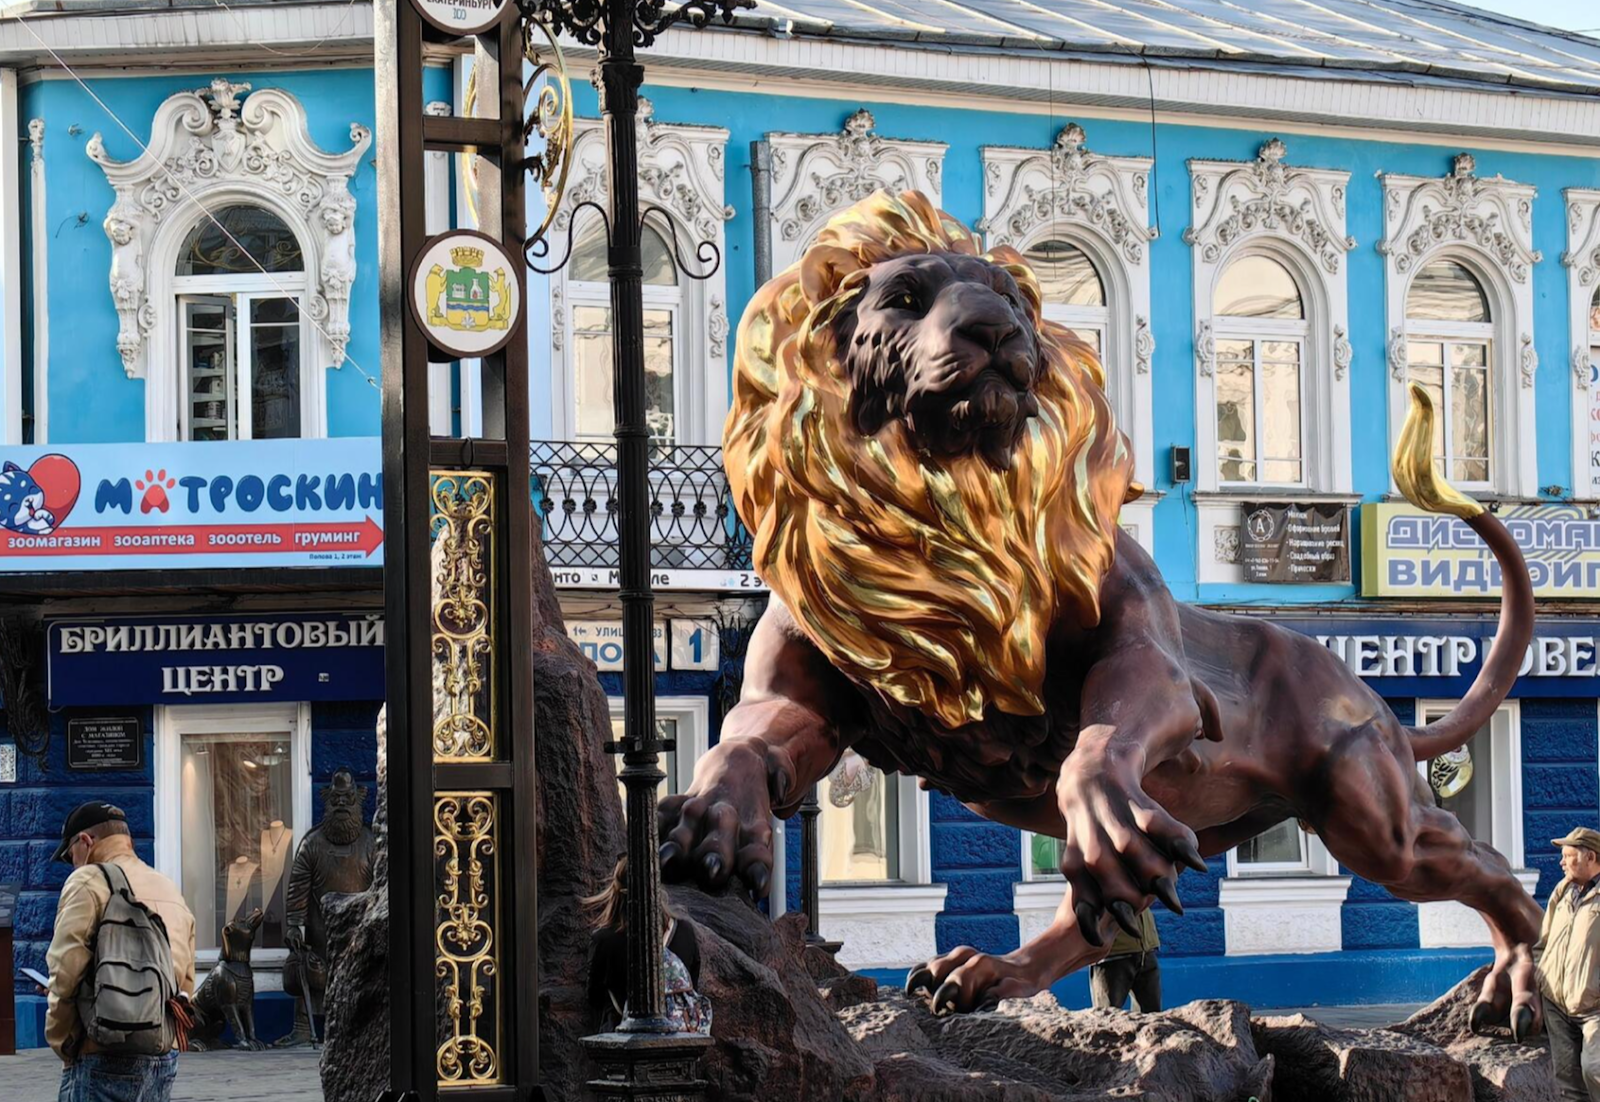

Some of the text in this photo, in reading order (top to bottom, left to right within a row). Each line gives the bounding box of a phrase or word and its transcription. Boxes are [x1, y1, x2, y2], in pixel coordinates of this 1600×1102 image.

[7, 531, 361, 549] зоомагазин зооаптека зооотель груминг
[1388, 515, 1600, 550] ДИСОМА
[740, 573, 750, 587] 2
[59, 614, 385, 653] БРИЛЛИАНТОВЫЙ
[688, 628, 702, 663] 1
[161, 665, 284, 696] ЦЕНТР
